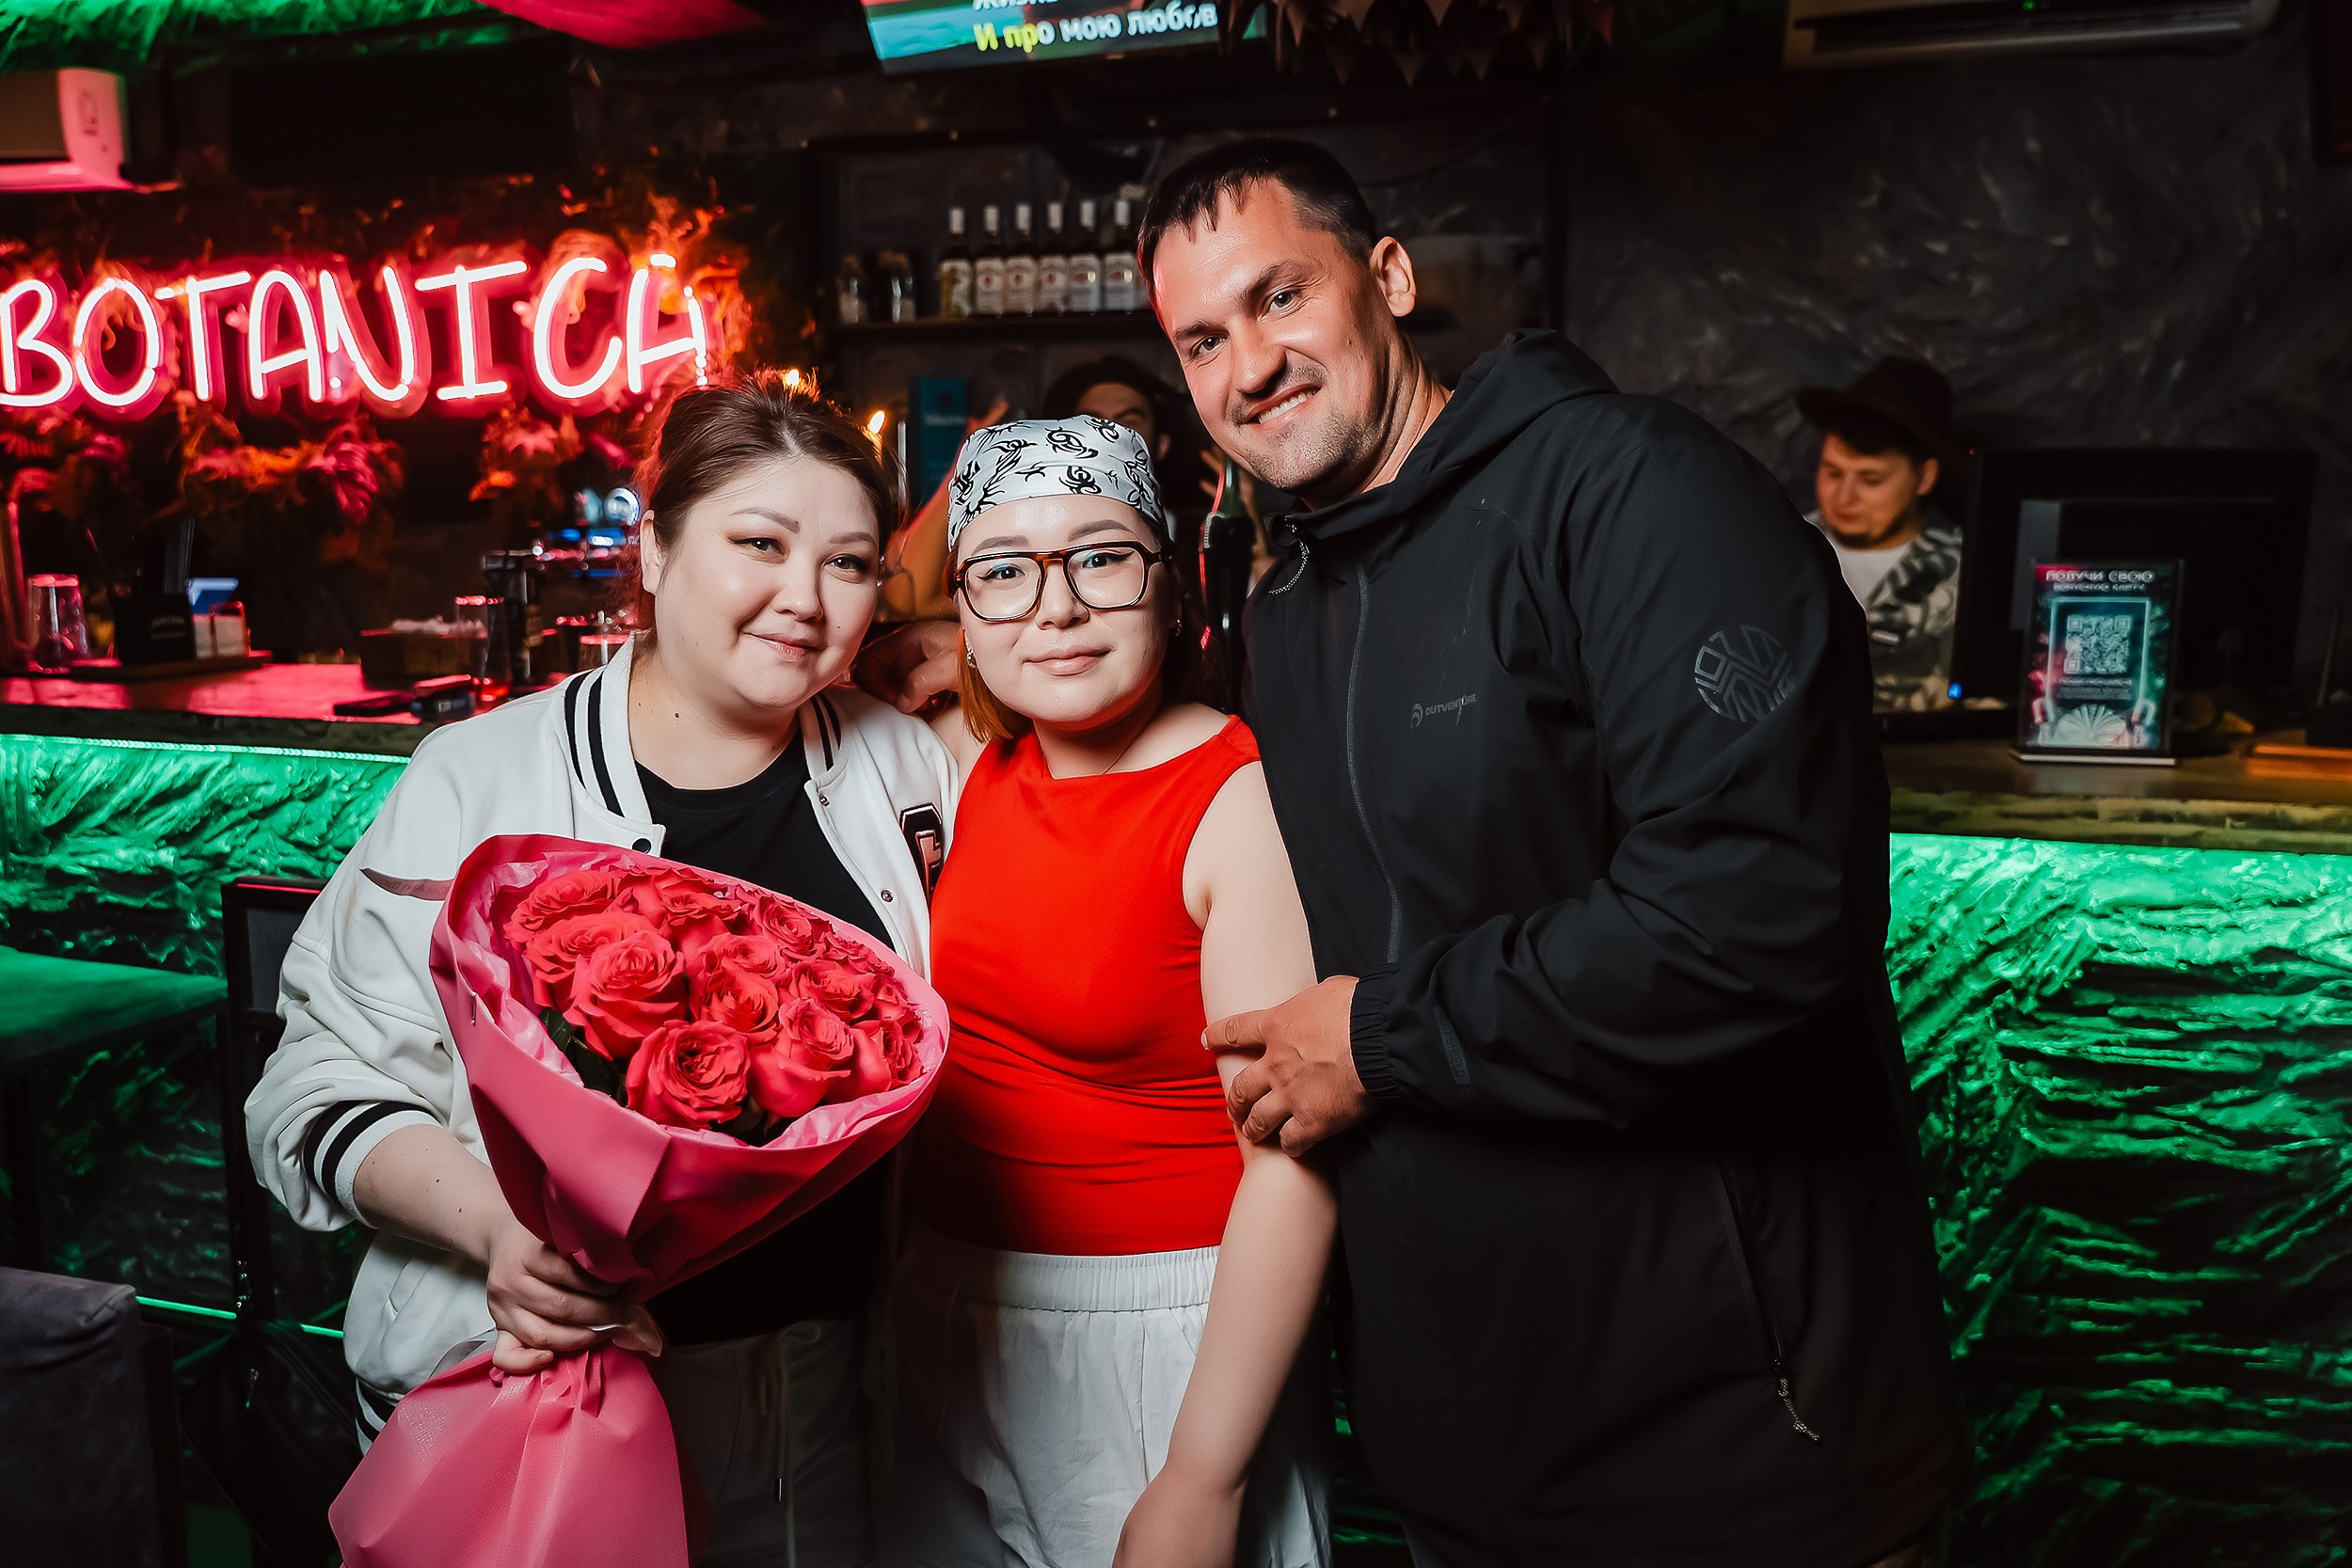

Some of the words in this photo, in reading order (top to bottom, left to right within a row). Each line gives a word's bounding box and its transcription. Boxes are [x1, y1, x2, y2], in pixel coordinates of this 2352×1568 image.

[973, 23, 998, 51] И
[1003, 21, 1055, 53] про
[1059, 13, 1121, 42] мою
[0, 254, 707, 406] BOTANICA
[2108, 570, 2155, 583] СВОЮ
[1425, 694, 1476, 716] OUTVENTURE
[1445, 1037, 1466, 1078] SHIELD
